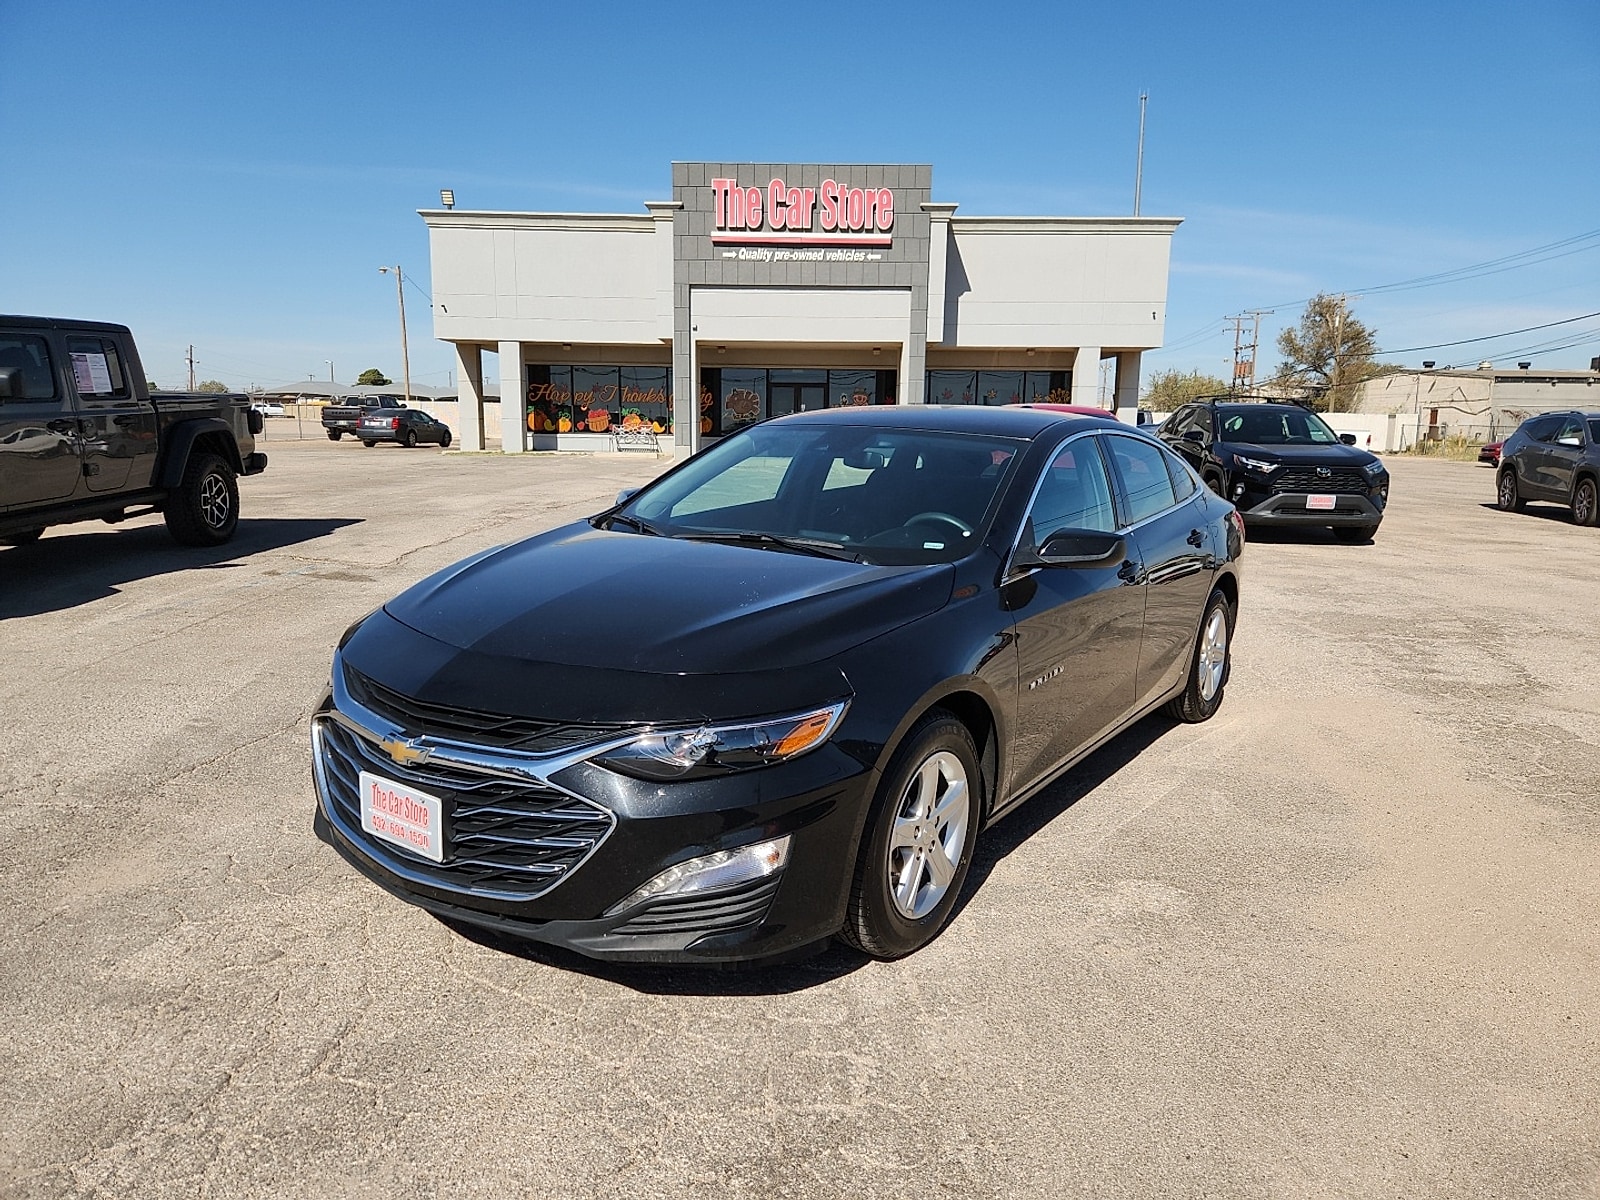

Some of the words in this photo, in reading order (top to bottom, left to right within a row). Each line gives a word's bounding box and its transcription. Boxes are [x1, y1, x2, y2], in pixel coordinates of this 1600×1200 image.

[711, 178, 763, 229] The
[767, 178, 816, 230] Car
[820, 179, 894, 230] Store
[738, 248, 770, 262] Quality
[774, 249, 824, 262] pre-owned
[826, 249, 865, 261] vehicles
[528, 383, 597, 411] Happy
[371, 783, 387, 811] The
[388, 791, 404, 817] Car
[404, 796, 429, 828] Store
